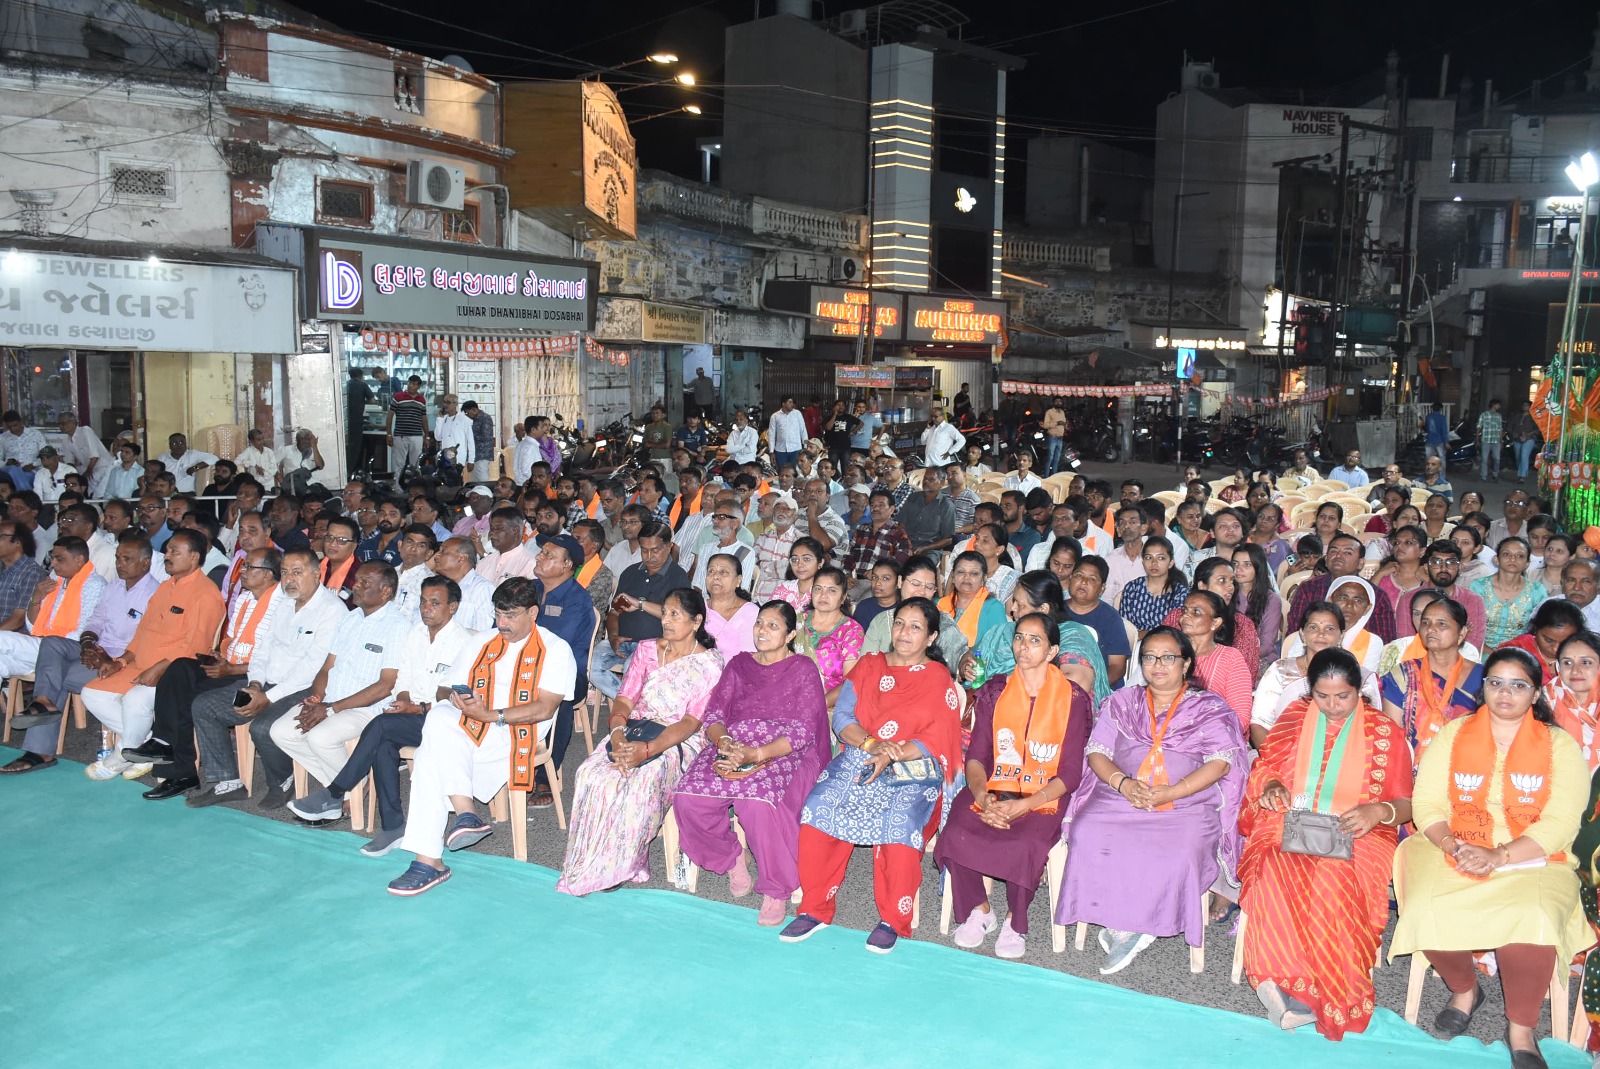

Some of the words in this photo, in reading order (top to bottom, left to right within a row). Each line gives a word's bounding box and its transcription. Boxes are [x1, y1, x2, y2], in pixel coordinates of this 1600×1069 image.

[1283, 110, 1344, 123] NAVNEET
[1292, 123, 1335, 135] HOUSE
[36, 259, 184, 282] JEWELLERS
[1522, 271, 1549, 279] SHYAM
[375, 263, 427, 294] લુહાર
[433, 267, 518, 296] ધનજીભાઈ
[523, 269, 587, 299] ડોસાભાઈ
[457, 305, 487, 317] LUHAR
[489, 307, 541, 320] DHANJIBHAI
[543, 310, 584, 322] DOSABHAI
[914, 309, 1001, 332] MURLIDHAR
[994, 764, 1022, 778] BJP
